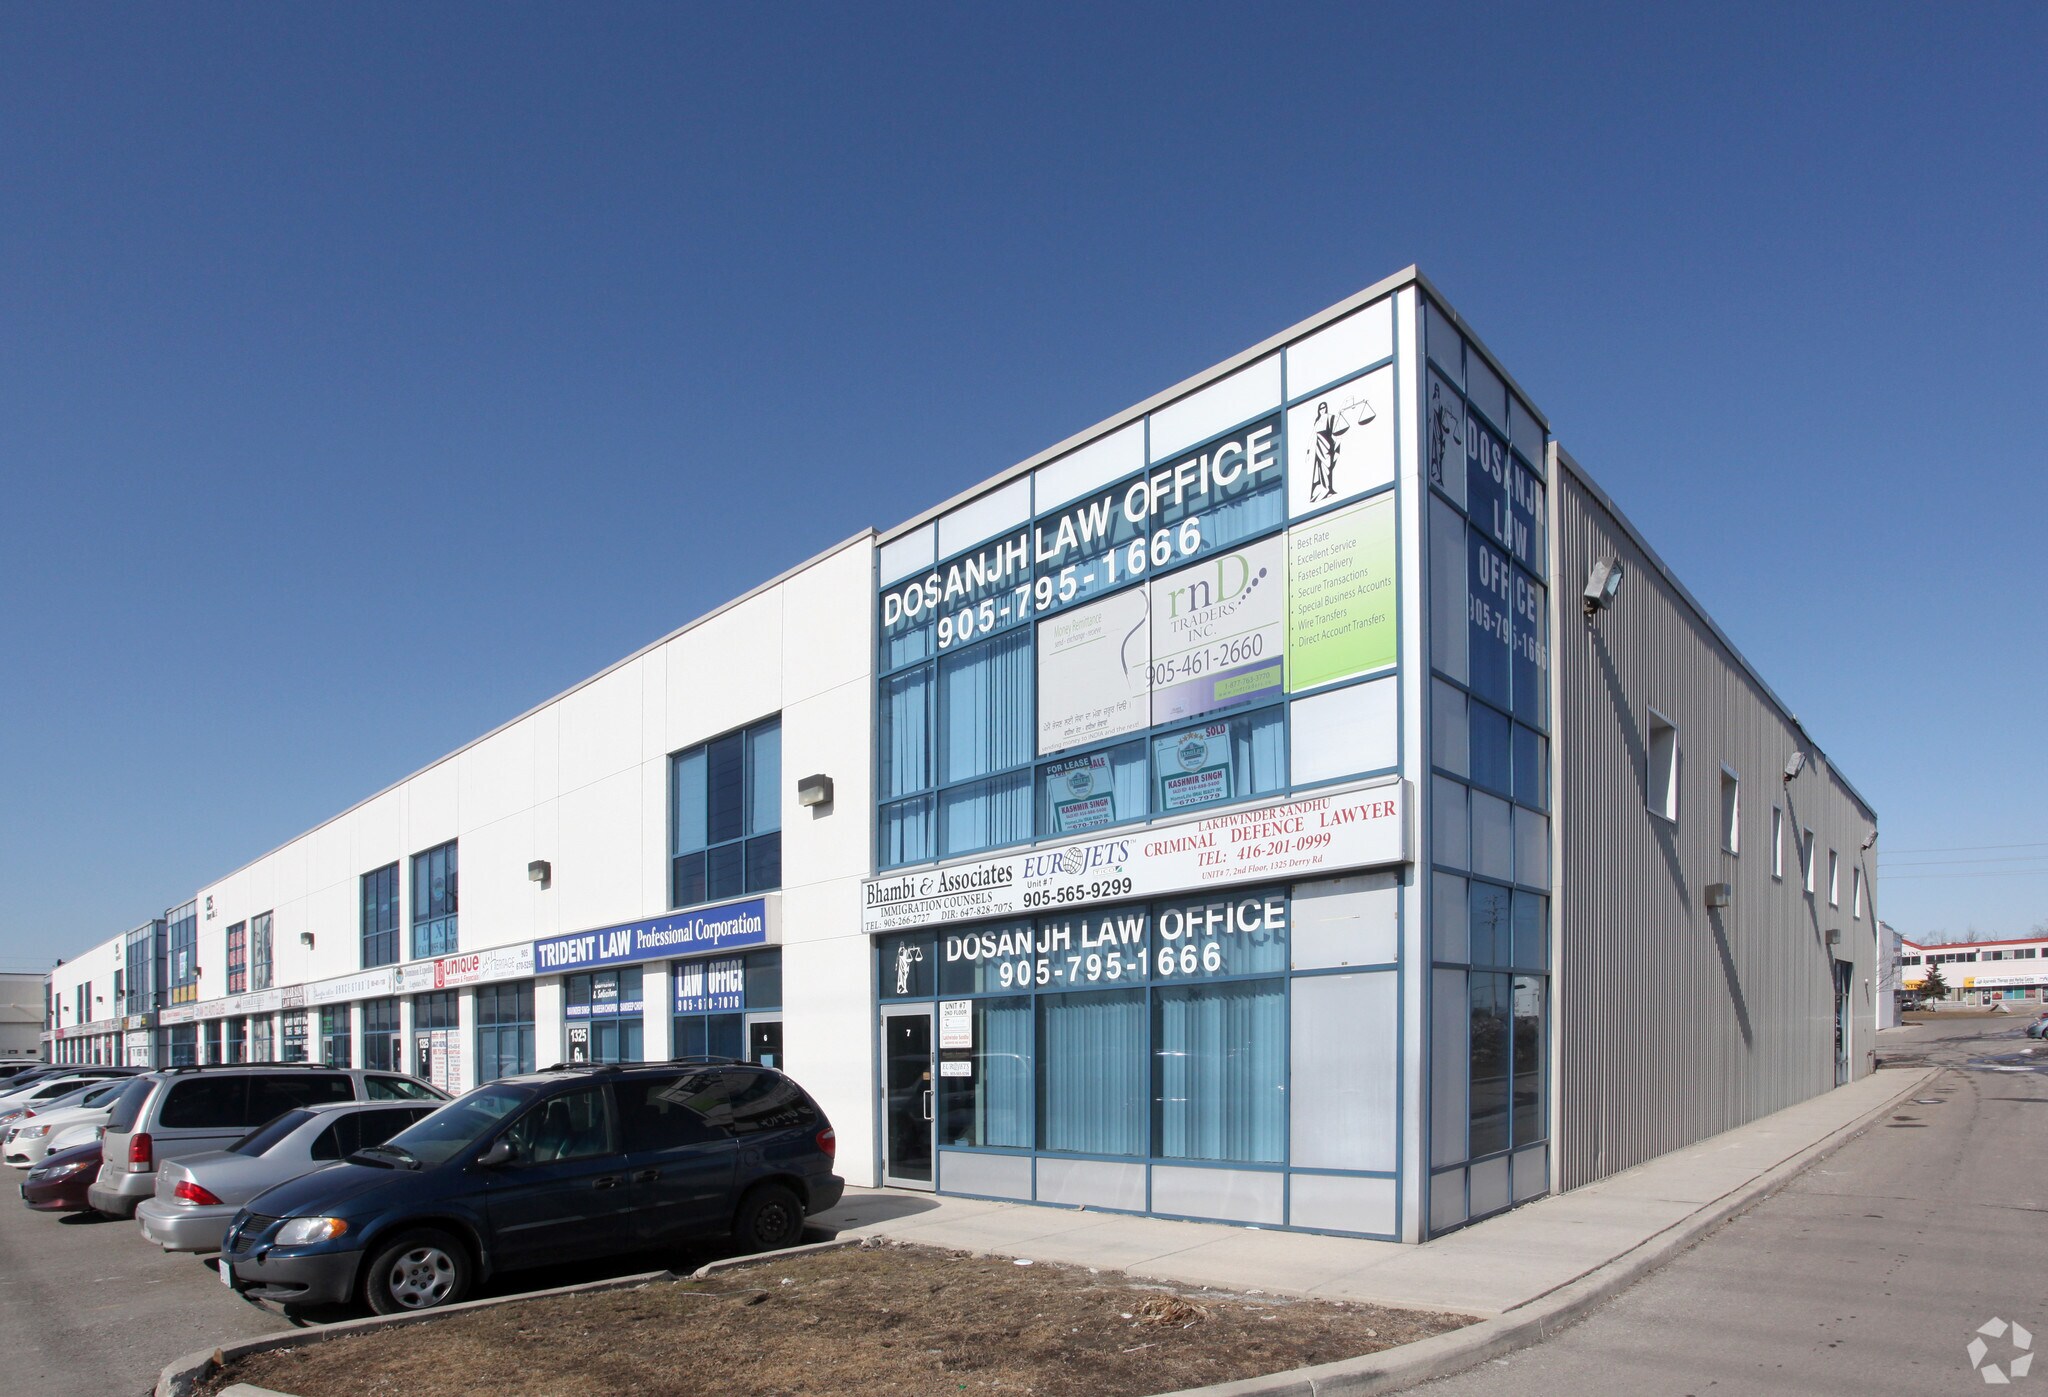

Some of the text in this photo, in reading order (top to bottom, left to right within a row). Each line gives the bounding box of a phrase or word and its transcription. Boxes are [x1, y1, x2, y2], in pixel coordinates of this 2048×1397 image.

[884, 425, 1274, 627] DOSANJH LAW OFFICE
[1297, 531, 1330, 550] Best Rate
[1493, 498, 1527, 562] LAW
[1297, 539, 1357, 566] Excellent Service
[937, 517, 1201, 648] 905-795-1666
[1297, 556, 1353, 582] Fastest Delivery
[1298, 567, 1369, 599] Secure Transactions
[1168, 553, 1249, 619] rnD
[1298, 577, 1392, 616] Special Business Accounts
[1170, 602, 1234, 633] TRADERS
[1298, 608, 1347, 631] Wire Transfers
[1298, 614, 1386, 647] Direct Account Transfers
[1187, 626, 1216, 642] INC.
[1146, 633, 1263, 687] 905-461-2660
[1041, 742, 1061, 752] sending
[1062, 738, 1080, 748] money
[1088, 731, 1104, 741] INDIA
[1104, 728, 1115, 736] and
[1116, 725, 1126, 733] the
[1206, 724, 1226, 737] SOLD
[1046, 758, 1089, 774] FOR LEASE
[1168, 771, 1223, 789] KASHMIR SINGH
[1061, 798, 1108, 814] KASHMIR SINGH
[1198, 798, 1331, 832] LAKHWINDER SANDHU
[1144, 800, 1397, 857] CRIMINAL DEFENCE LAWYER
[1197, 832, 1332, 867] TEL: 416-201-0999
[1233, 866, 1246, 875] 2nd
[1248, 862, 1268, 873] Floor,
[1270, 859, 1287, 870] 1325
[1289, 857, 1310, 869] Derry
[1311, 855, 1323, 864] Rd
[867, 864, 1013, 905] Bhambi & Associates
[1023, 877, 1132, 908] 905-565-9299
[1027, 880, 1042, 888] Unit
[881, 891, 993, 917] IMMIGRATION COUNSELS
[941, 902, 1013, 920] DIR: 647-828-7075
[865, 913, 930, 931] TEL: 905-266-2727
[947, 896, 1285, 961] DOSANJH LAW OFFICE
[538, 912, 761, 967] TRIDENT LAW Professional Corporation
[678, 959, 743, 998] LAW OFFICE
[1000, 942, 1221, 988] 905-795-1666
[570, 1028, 587, 1042] 1325
[906, 1029, 911, 1037] 7
[422, 1050, 426, 1062] 5
